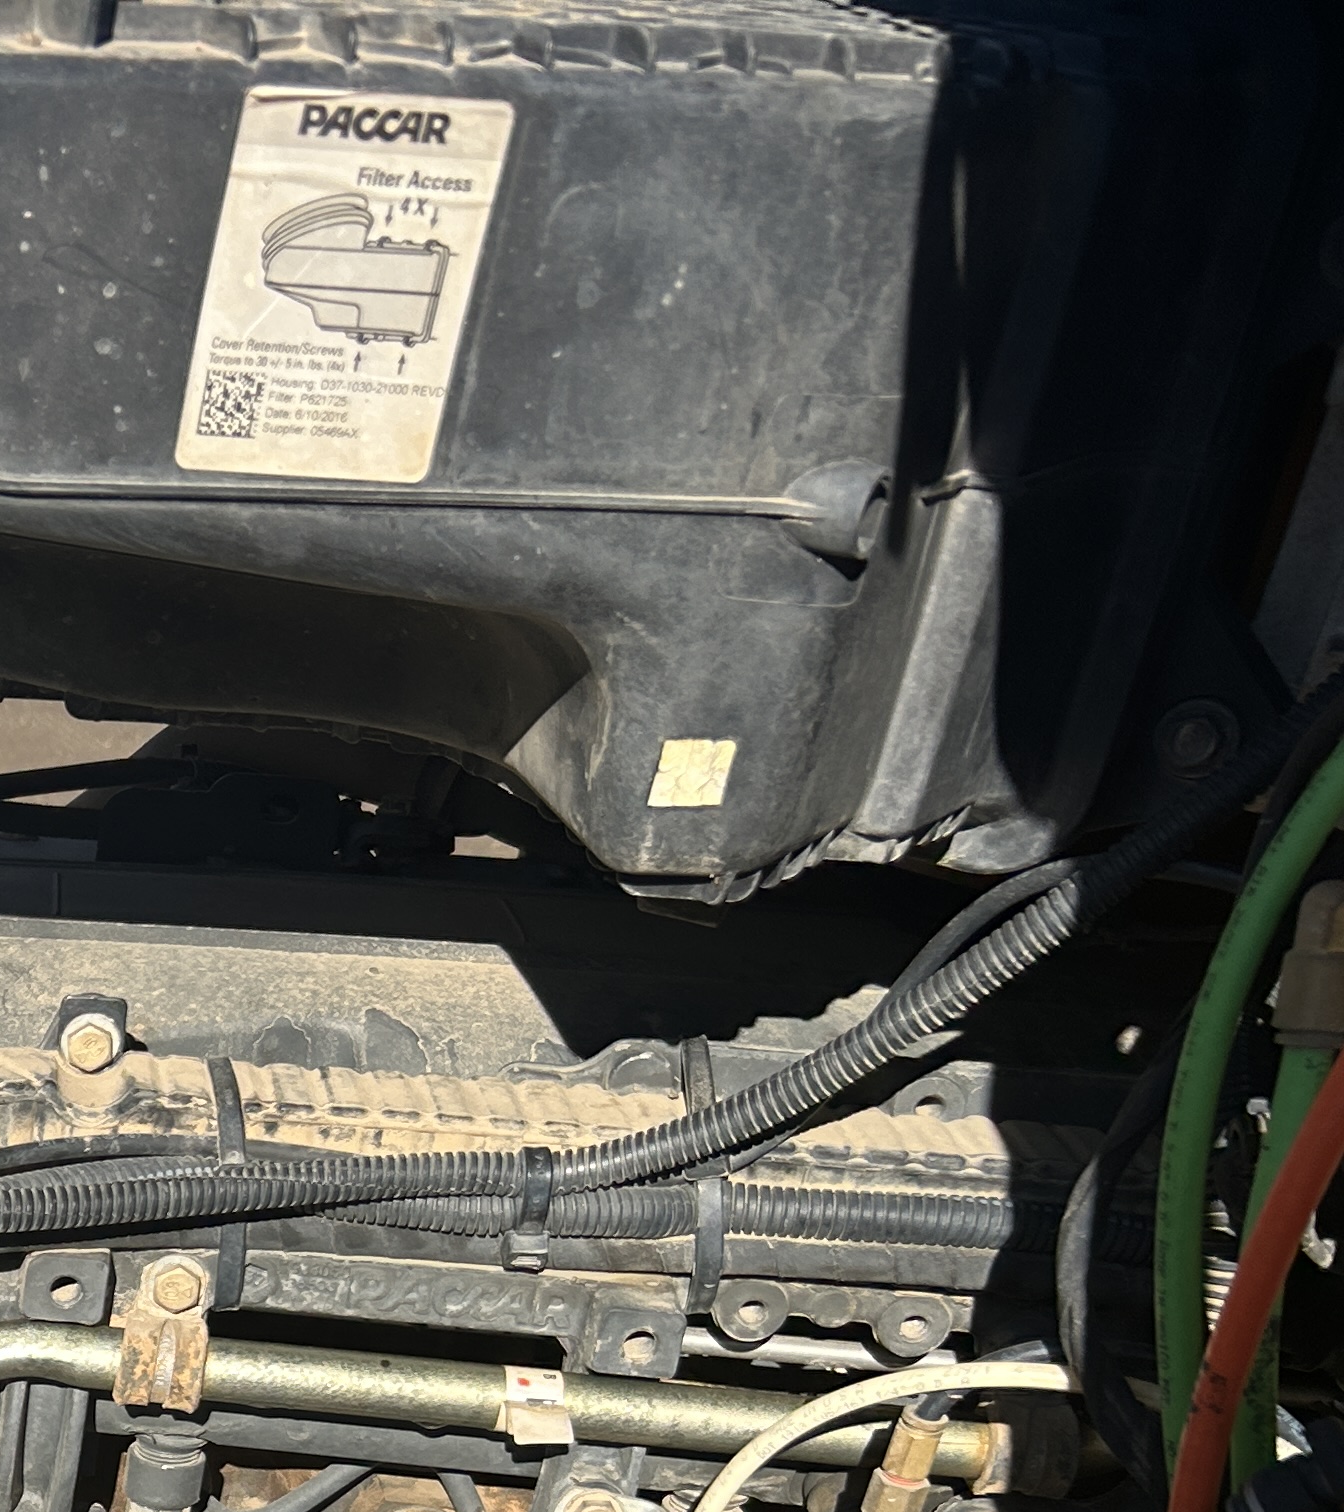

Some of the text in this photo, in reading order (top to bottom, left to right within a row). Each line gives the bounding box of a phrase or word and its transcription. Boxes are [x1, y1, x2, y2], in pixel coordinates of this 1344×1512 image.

[298, 104, 450, 144] PACCAR
[357, 167, 473, 191] Filter Access
[400, 198, 428, 215] 4 X
[211, 336, 344, 357] Cover Retention/Screws
[209, 353, 241, 367] Torque
[244, 355, 254, 366] to
[307, 359, 324, 371] lbs.
[271, 377, 315, 392] Housing:
[320, 380, 409, 396] D37-1030-21000
[268, 391, 348, 407] Filter: P621725
[264, 407, 290, 419] Date:
[262, 422, 306, 436] Supplier:
[350, 1268, 571, 1330] PACCAR
